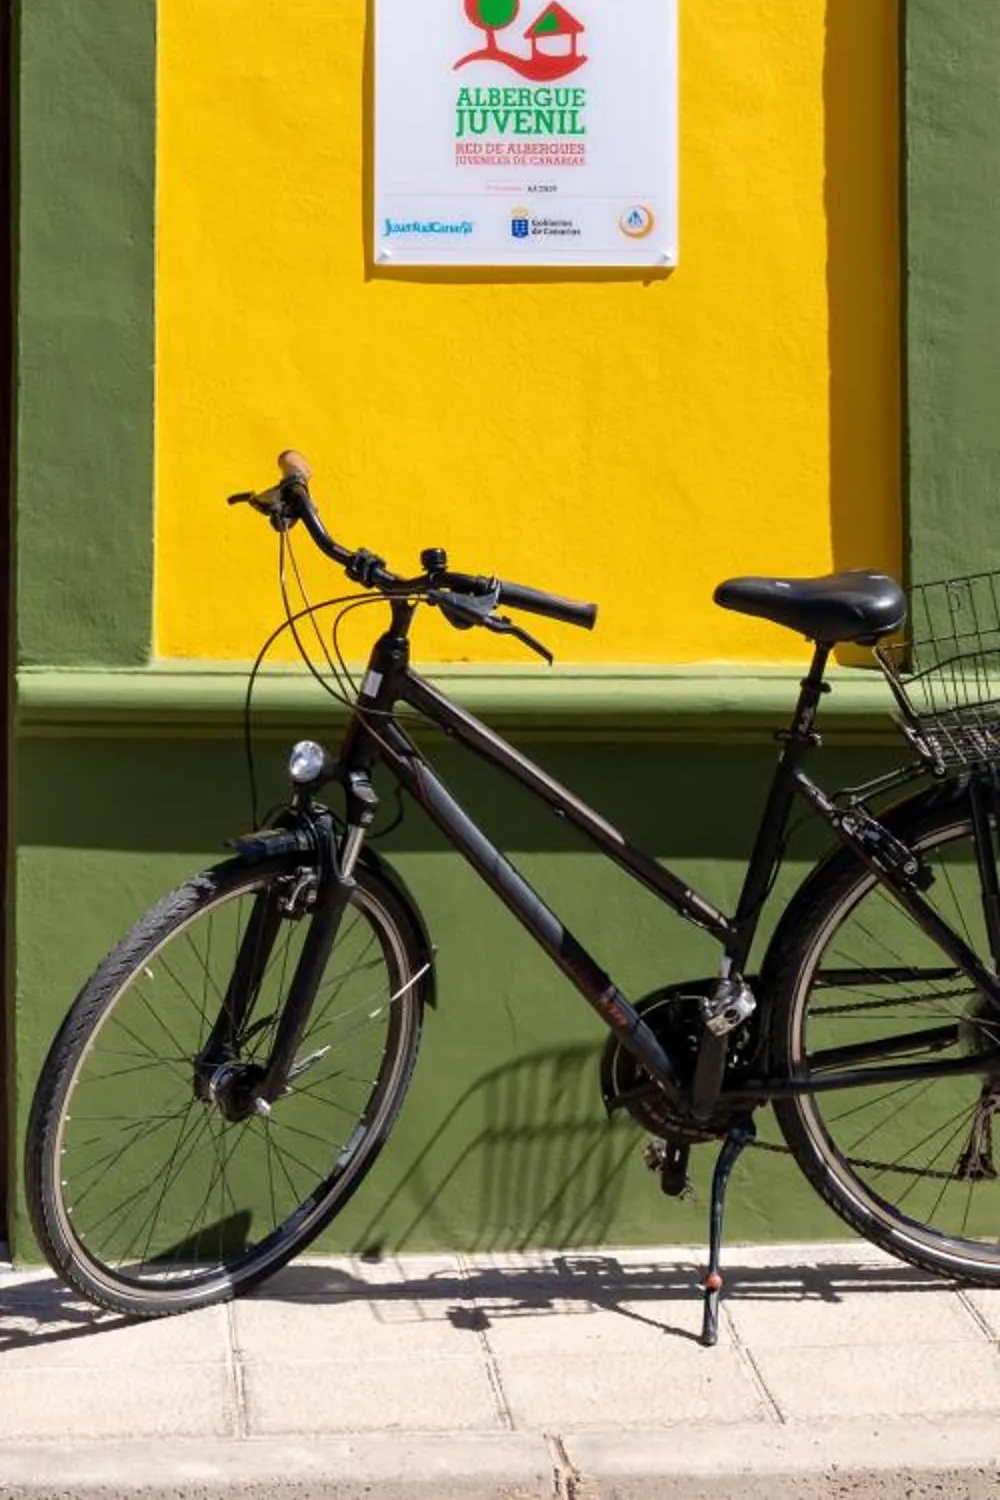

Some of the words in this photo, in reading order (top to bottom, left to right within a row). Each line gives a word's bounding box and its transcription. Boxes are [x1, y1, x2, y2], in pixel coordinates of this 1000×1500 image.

[455, 87, 586, 107] ALBERGUE
[455, 109, 586, 137] JUVENIL
[455, 142, 483, 155] RED
[486, 142, 504, 155] DE
[507, 142, 586, 155] ALBERGUES
[529, 155, 586, 166] CANARIAS
